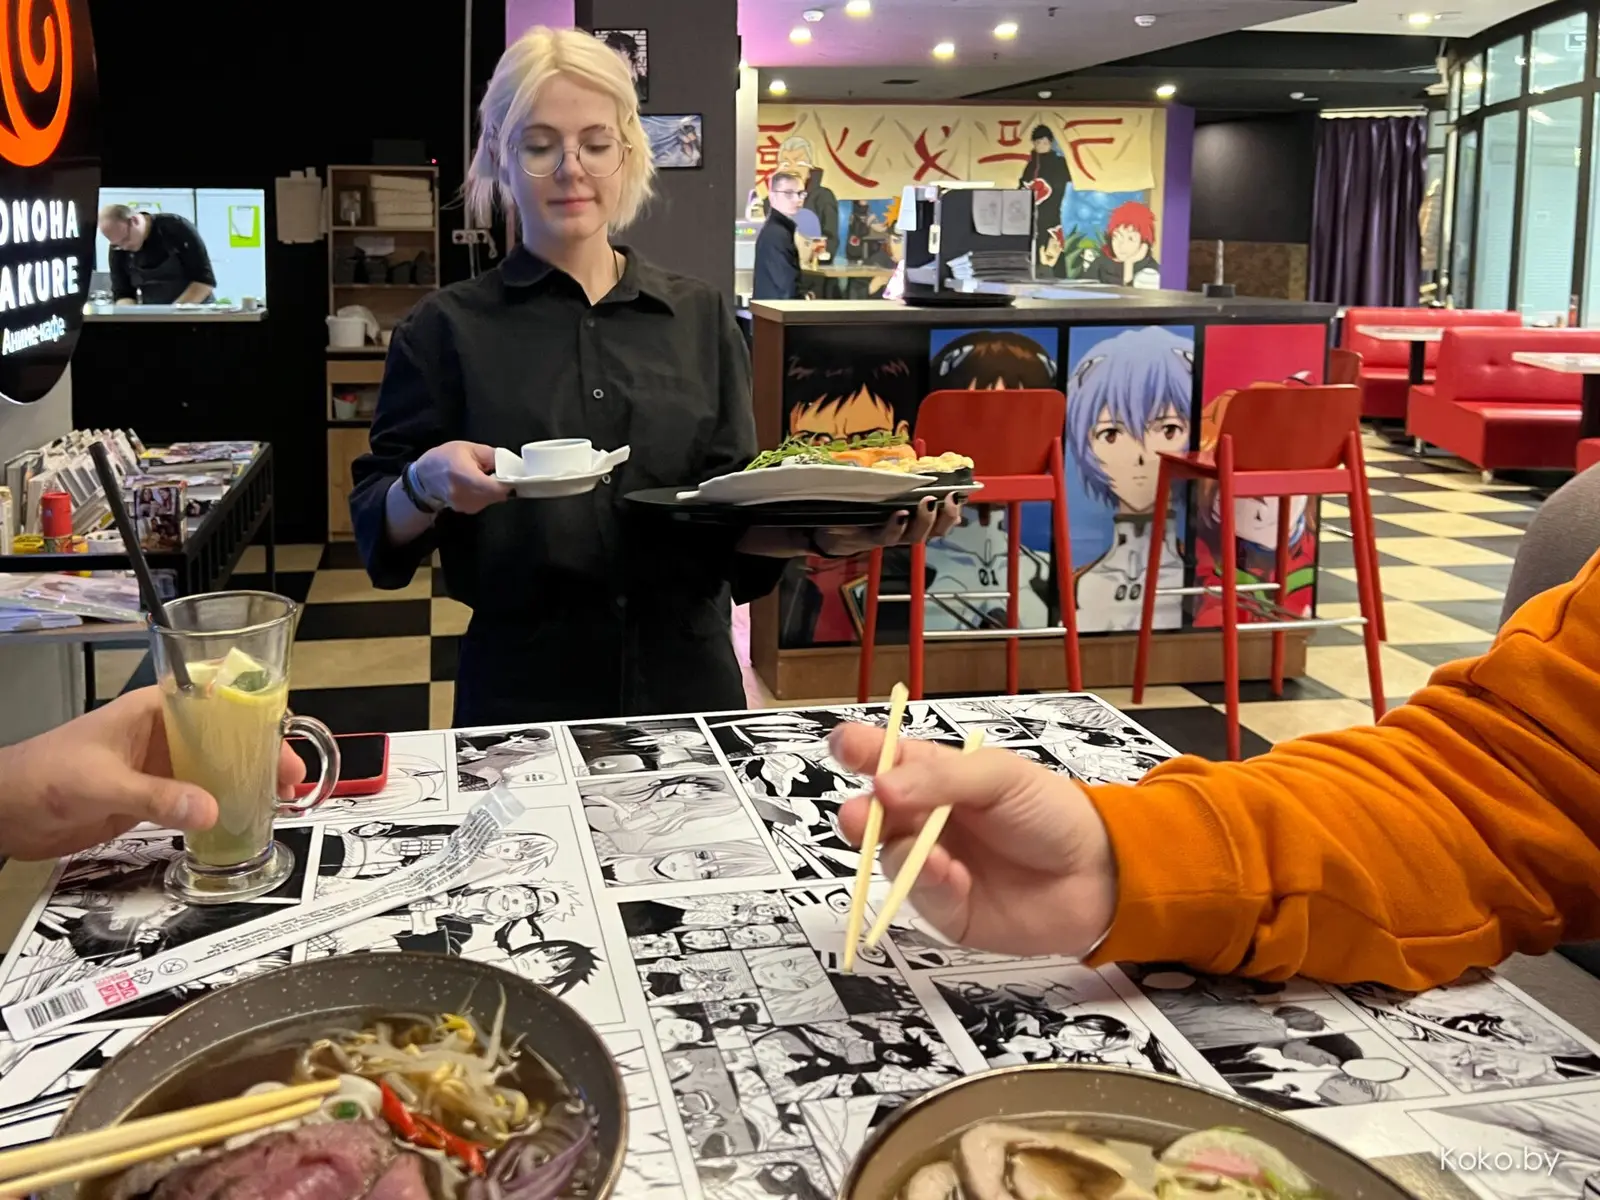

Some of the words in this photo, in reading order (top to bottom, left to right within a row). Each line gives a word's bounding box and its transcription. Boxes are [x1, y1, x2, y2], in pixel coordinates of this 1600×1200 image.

[0, 256, 79, 312] AKURE
[979, 569, 999, 586] 01
[1114, 584, 1142, 601] 00
